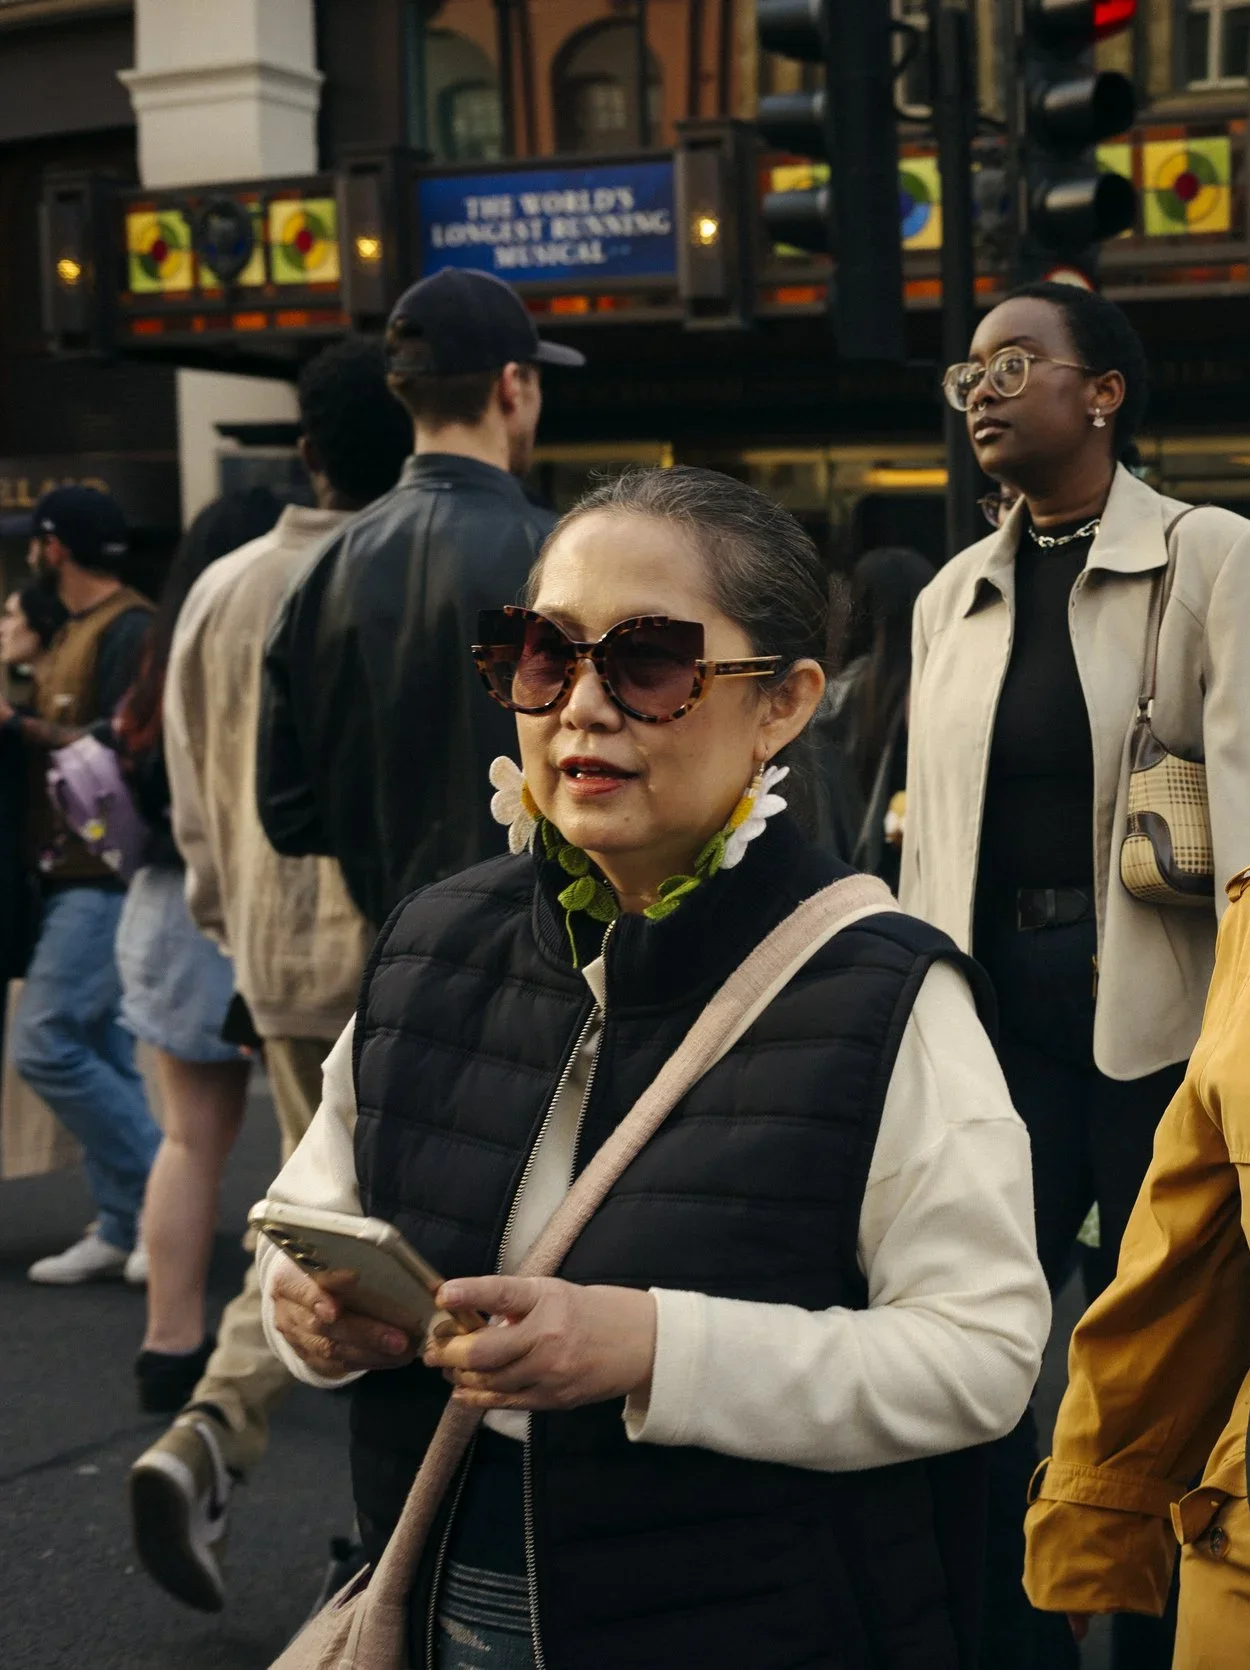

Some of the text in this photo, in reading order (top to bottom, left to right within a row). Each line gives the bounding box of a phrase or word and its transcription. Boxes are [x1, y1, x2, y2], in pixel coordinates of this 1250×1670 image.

[464, 186, 635, 221] THE WORLD'S
[431, 209, 671, 248] LONGEST RUNNING
[493, 240, 607, 268] MUSICAL
